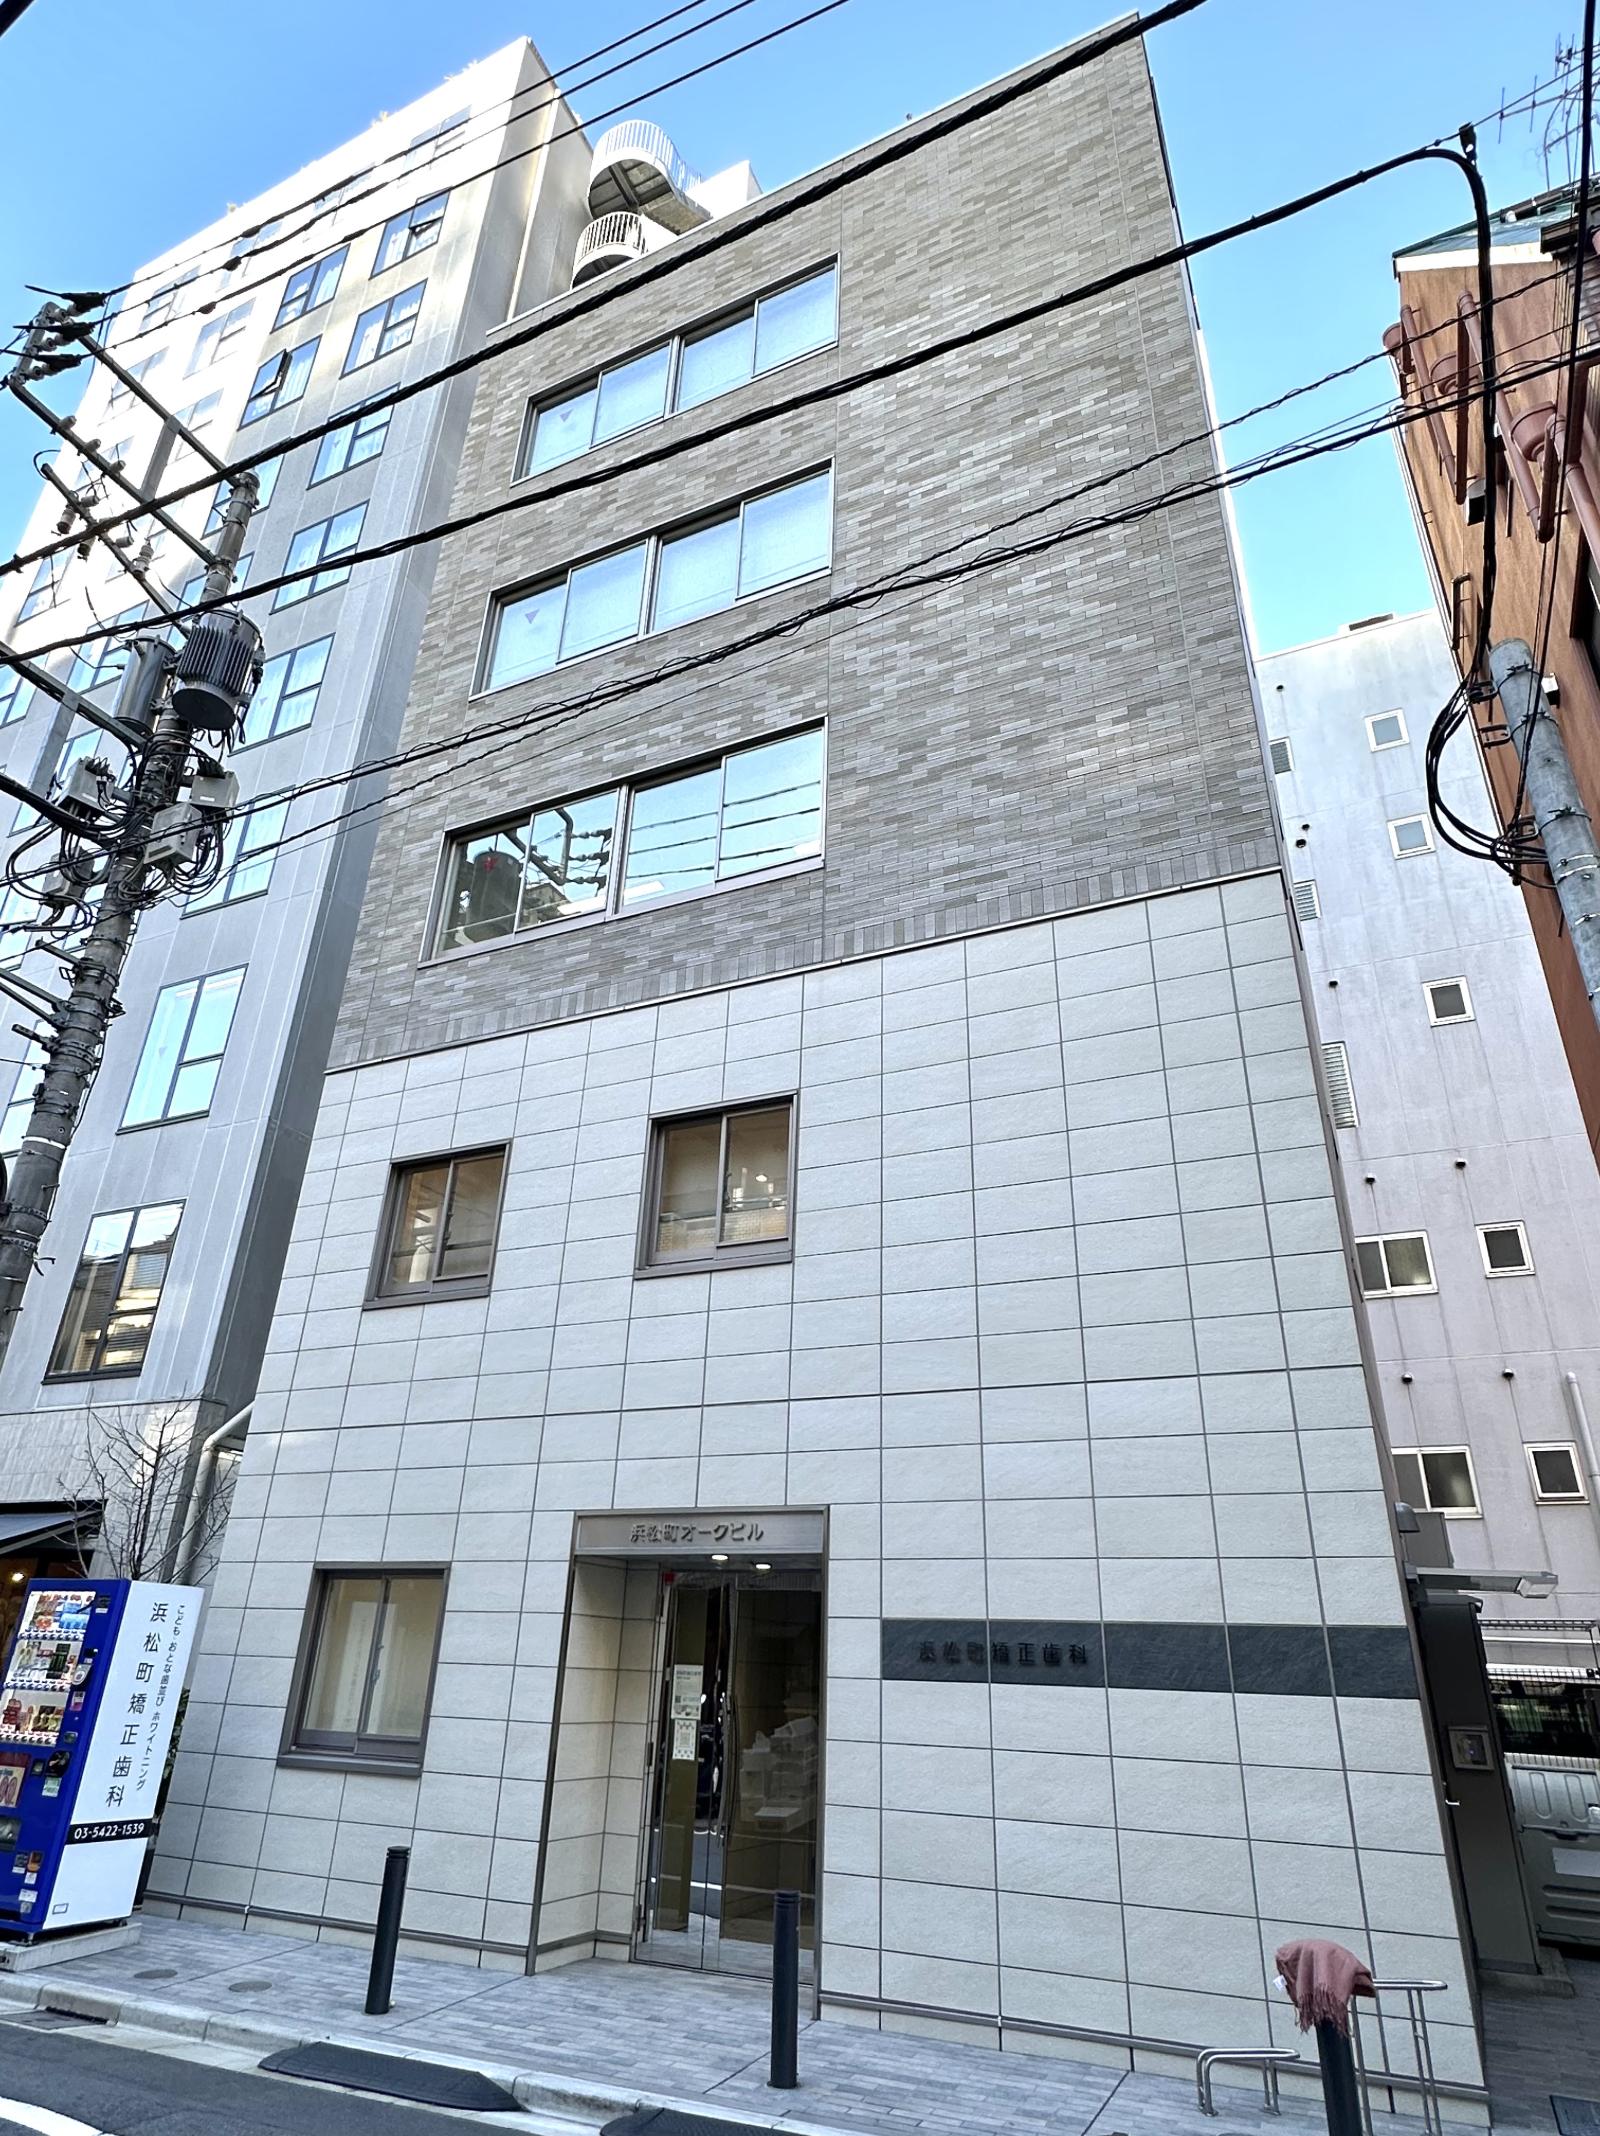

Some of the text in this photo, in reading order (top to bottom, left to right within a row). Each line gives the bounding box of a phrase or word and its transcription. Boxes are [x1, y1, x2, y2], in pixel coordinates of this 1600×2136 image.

[630, 1523, 764, 1543] 浜松町オークビル
[105, 1602, 169, 1808] 浜松町矯正歯科
[74, 1823, 145, 1840] 03-5422-1539
